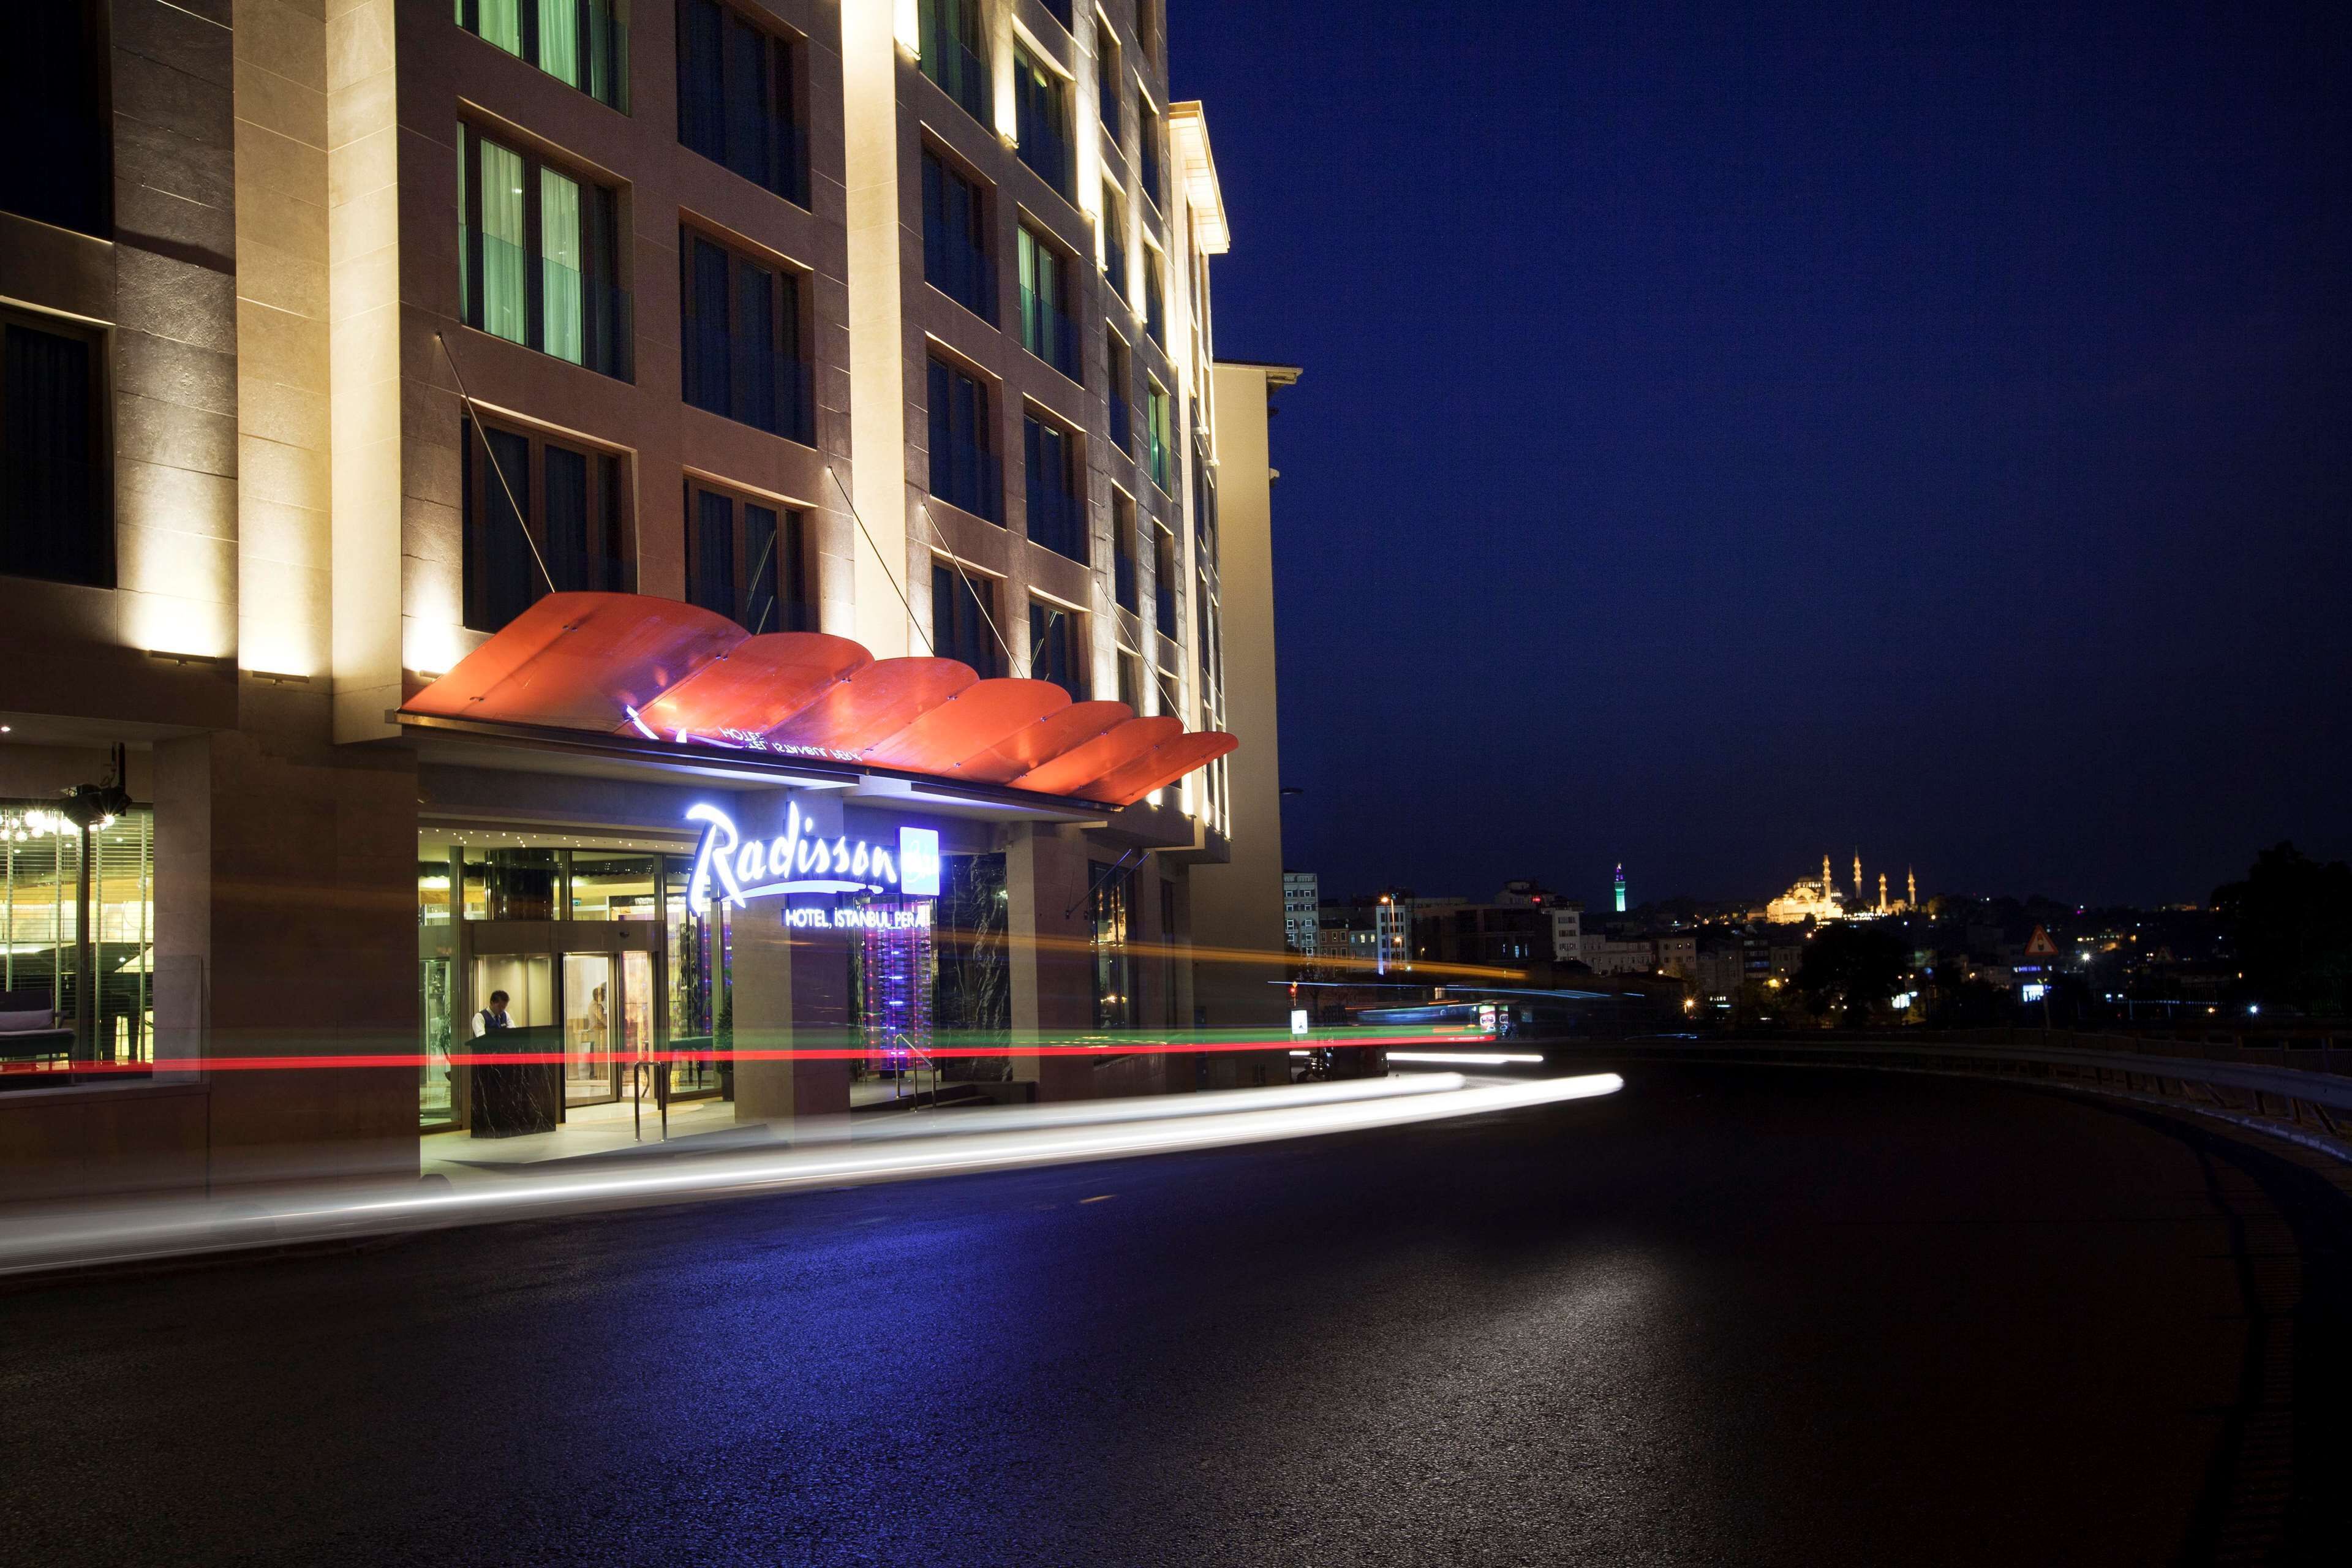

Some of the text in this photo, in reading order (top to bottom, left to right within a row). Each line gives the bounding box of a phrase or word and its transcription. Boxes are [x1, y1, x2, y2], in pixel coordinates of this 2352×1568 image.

[686, 801, 897, 917] Radisson
[785, 909, 832, 929] HOTEL,
[894, 911, 925, 927] PERA
